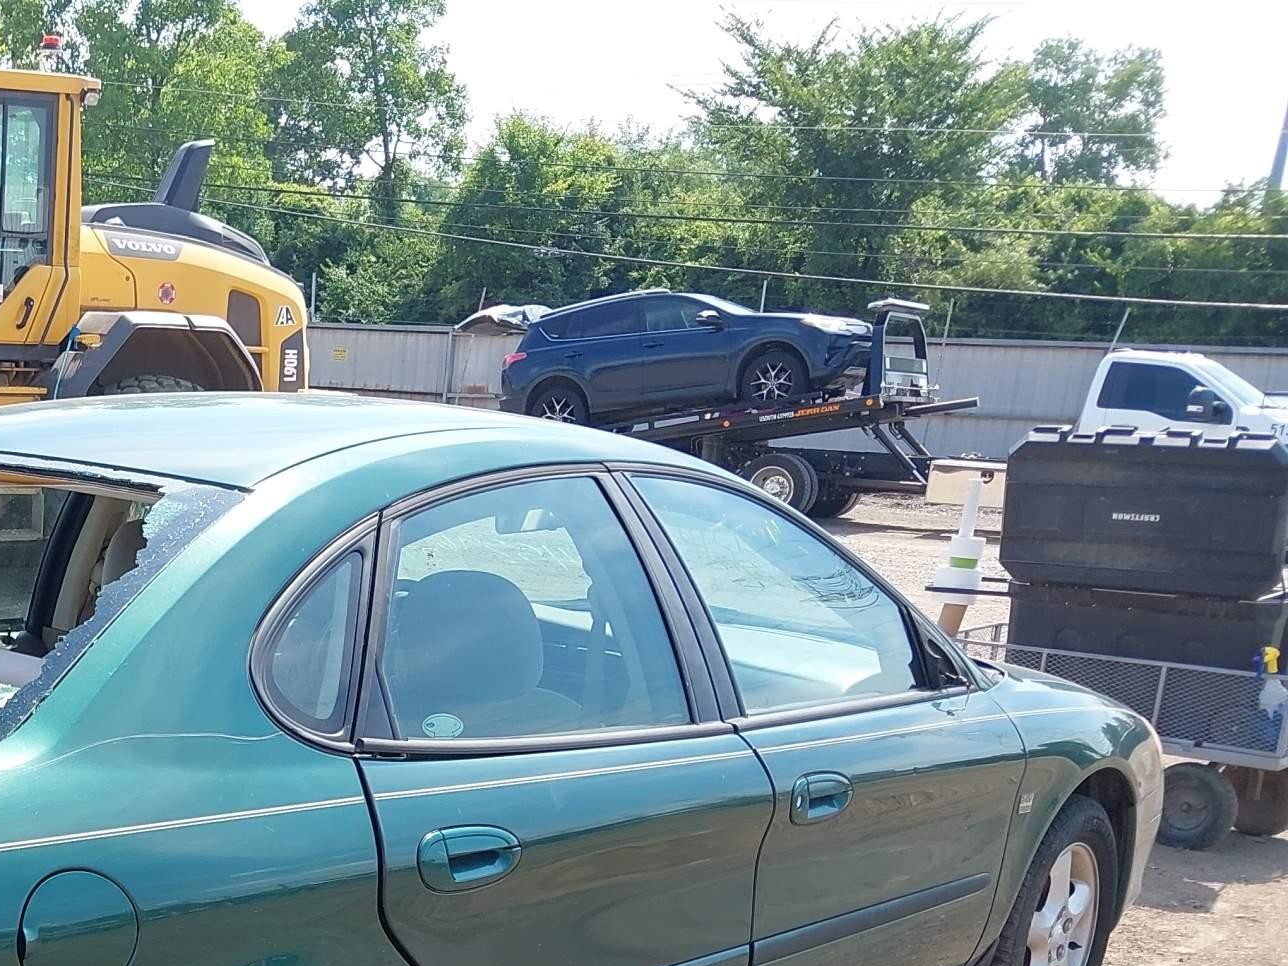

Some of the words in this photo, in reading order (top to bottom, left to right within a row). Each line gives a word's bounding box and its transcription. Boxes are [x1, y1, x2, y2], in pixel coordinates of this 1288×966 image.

[112, 238, 176, 255] VOLVO
[283, 349, 298, 382] L90H
[1111, 512, 1161, 523] CRAFTSMAN
